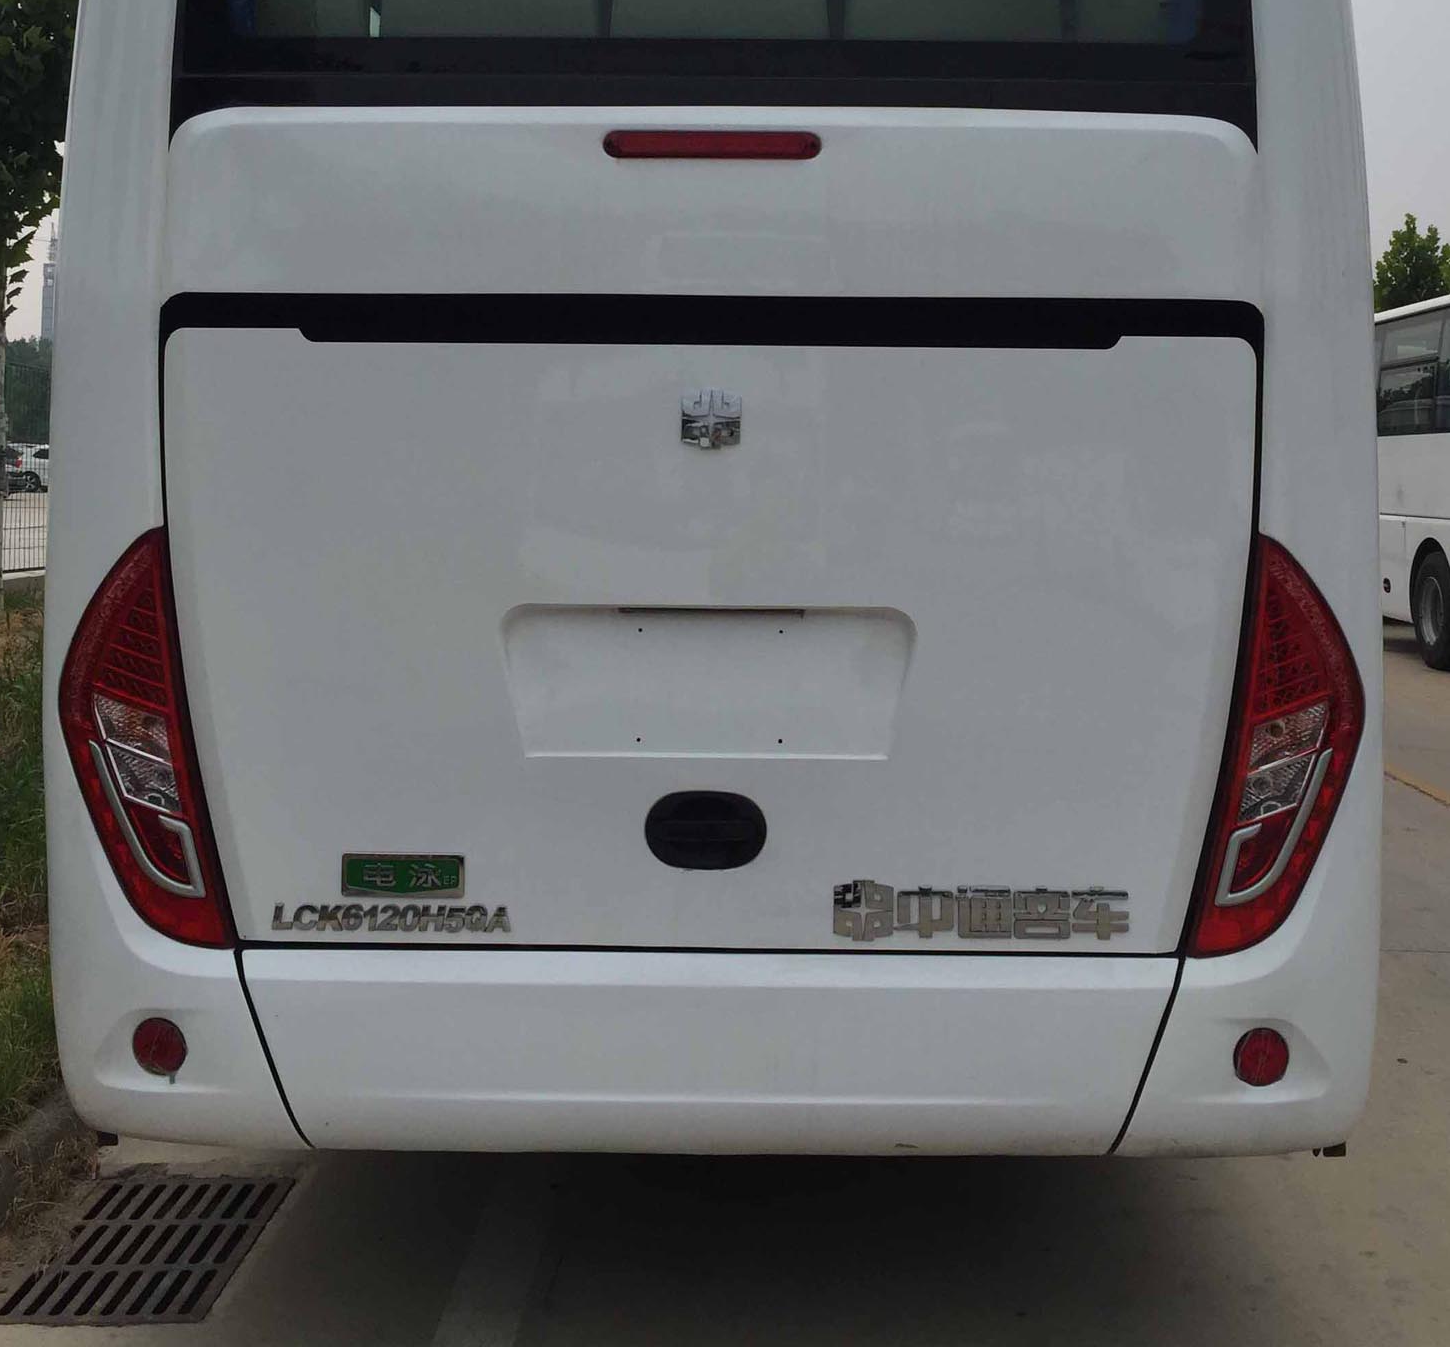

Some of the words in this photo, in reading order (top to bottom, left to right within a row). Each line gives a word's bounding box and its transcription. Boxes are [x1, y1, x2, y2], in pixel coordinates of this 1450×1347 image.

[362, 862, 442, 887] 电泳
[893, 885, 1130, 940] 中通客车
